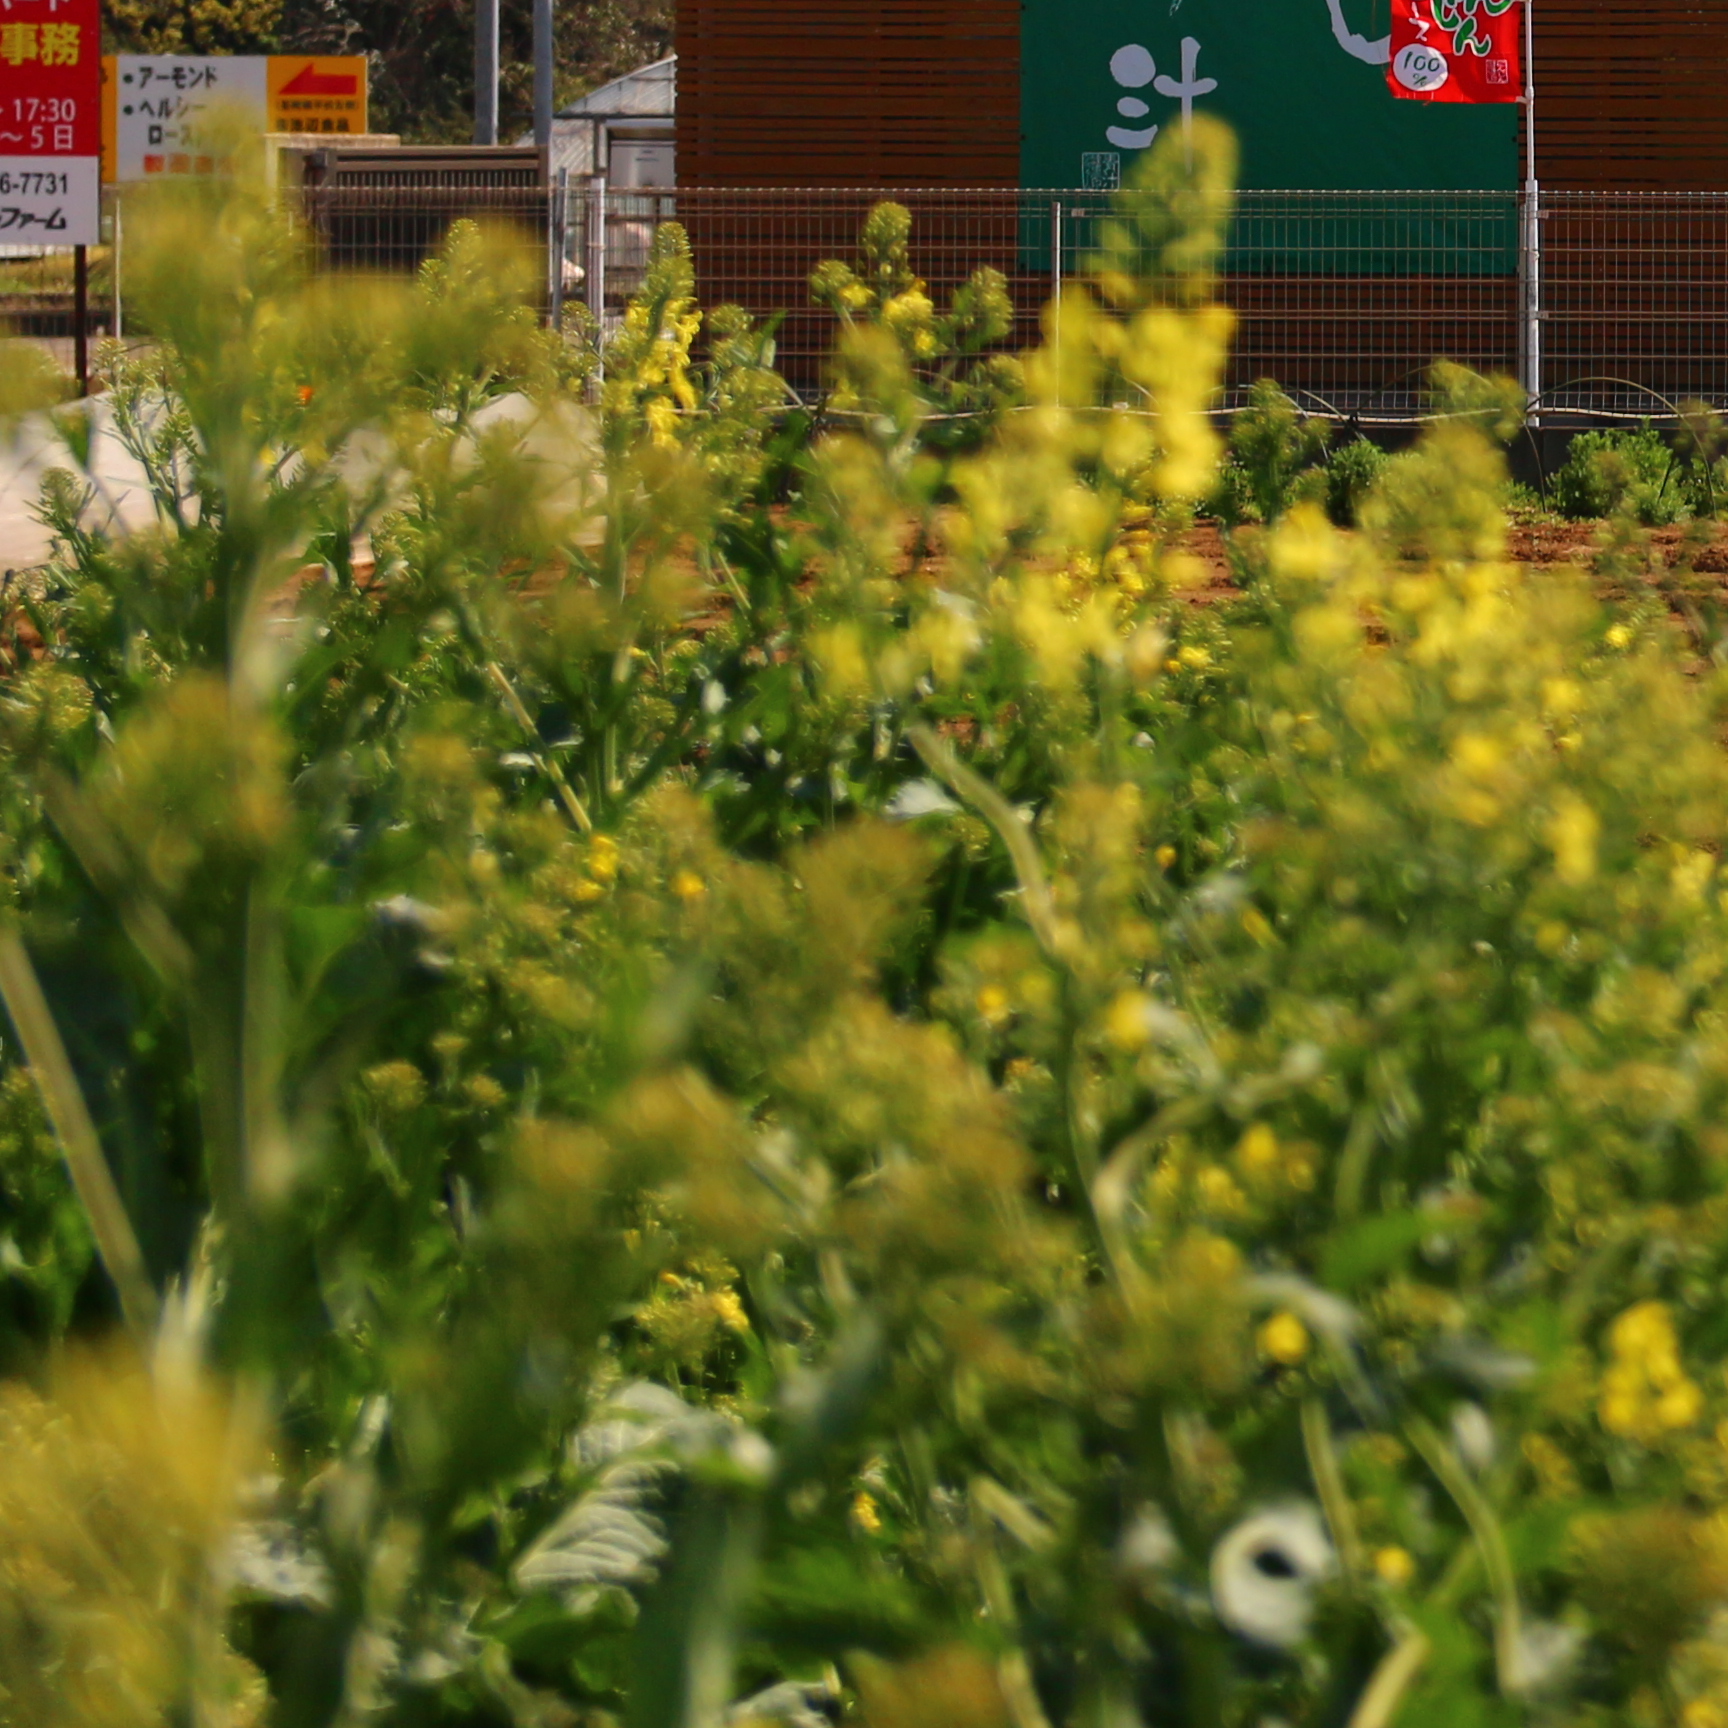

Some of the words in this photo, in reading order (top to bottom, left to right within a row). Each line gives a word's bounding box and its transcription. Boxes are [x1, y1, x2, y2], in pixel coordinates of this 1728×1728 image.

[0, 23, 81, 66] 事務
[139, 65, 218, 89] アーモンド
[14, 98, 76, 123] 17:30
[0, 172, 68, 195] 6-7731
